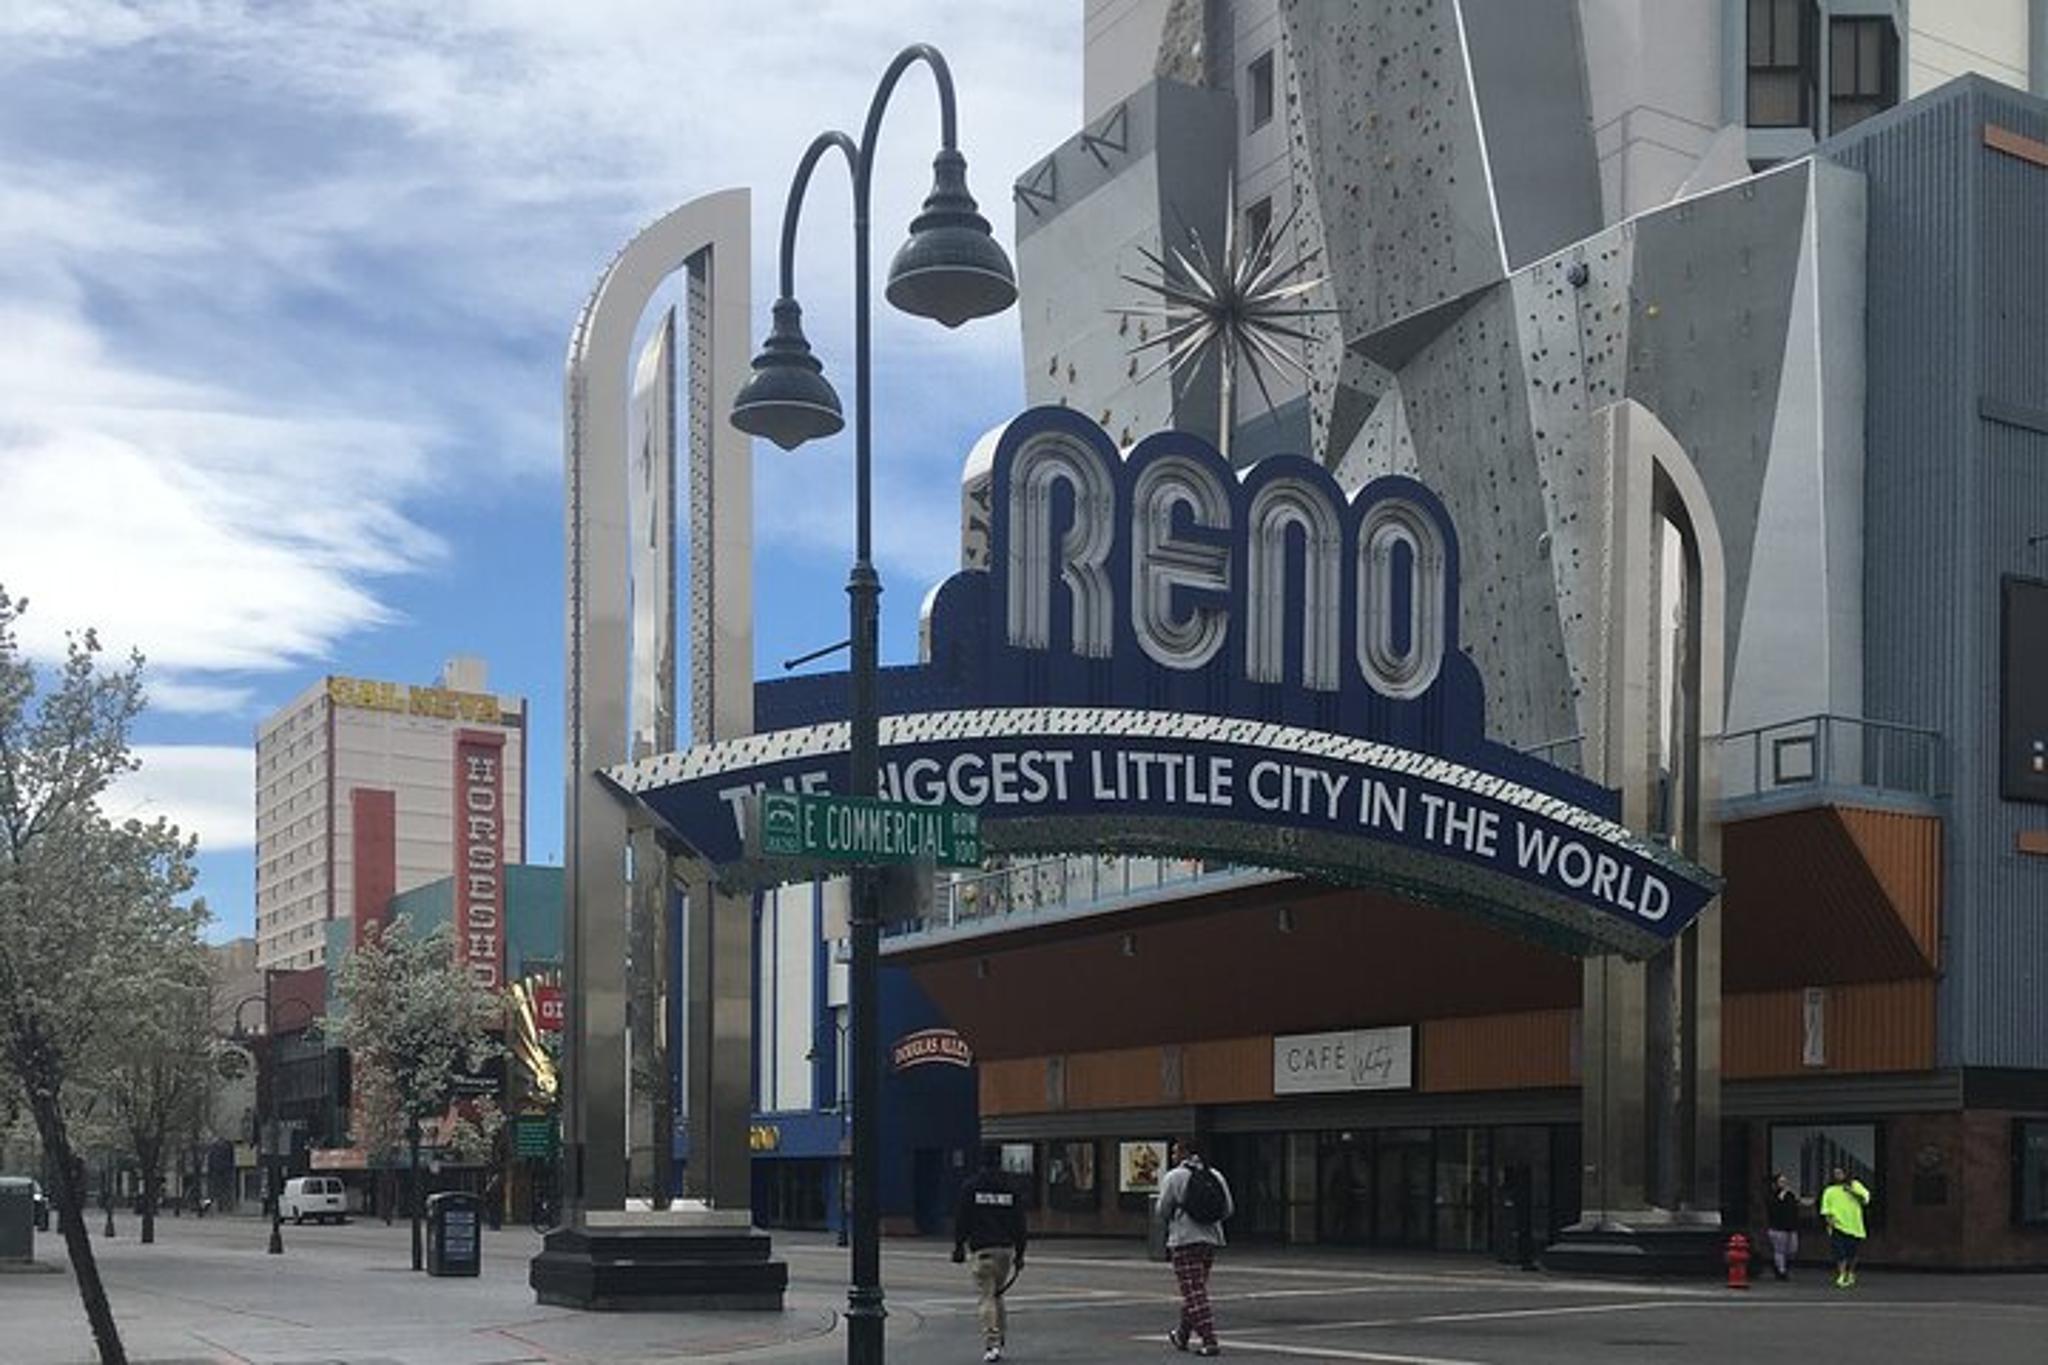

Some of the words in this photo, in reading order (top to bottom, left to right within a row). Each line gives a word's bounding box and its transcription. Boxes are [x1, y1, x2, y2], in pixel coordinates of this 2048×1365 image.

[804, 803, 817, 848] E
[827, 804, 948, 857] COMMERCIAL
[878, 750, 1073, 807] IGGEST
[1091, 750, 1234, 806] LITTLE
[1249, 760, 1349, 820] CITY
[1359, 778, 1407, 832] IN
[1420, 792, 1500, 858] THE
[1516, 821, 1671, 922] WORLD
[1287, 1040, 1346, 1073] CAFÉ
